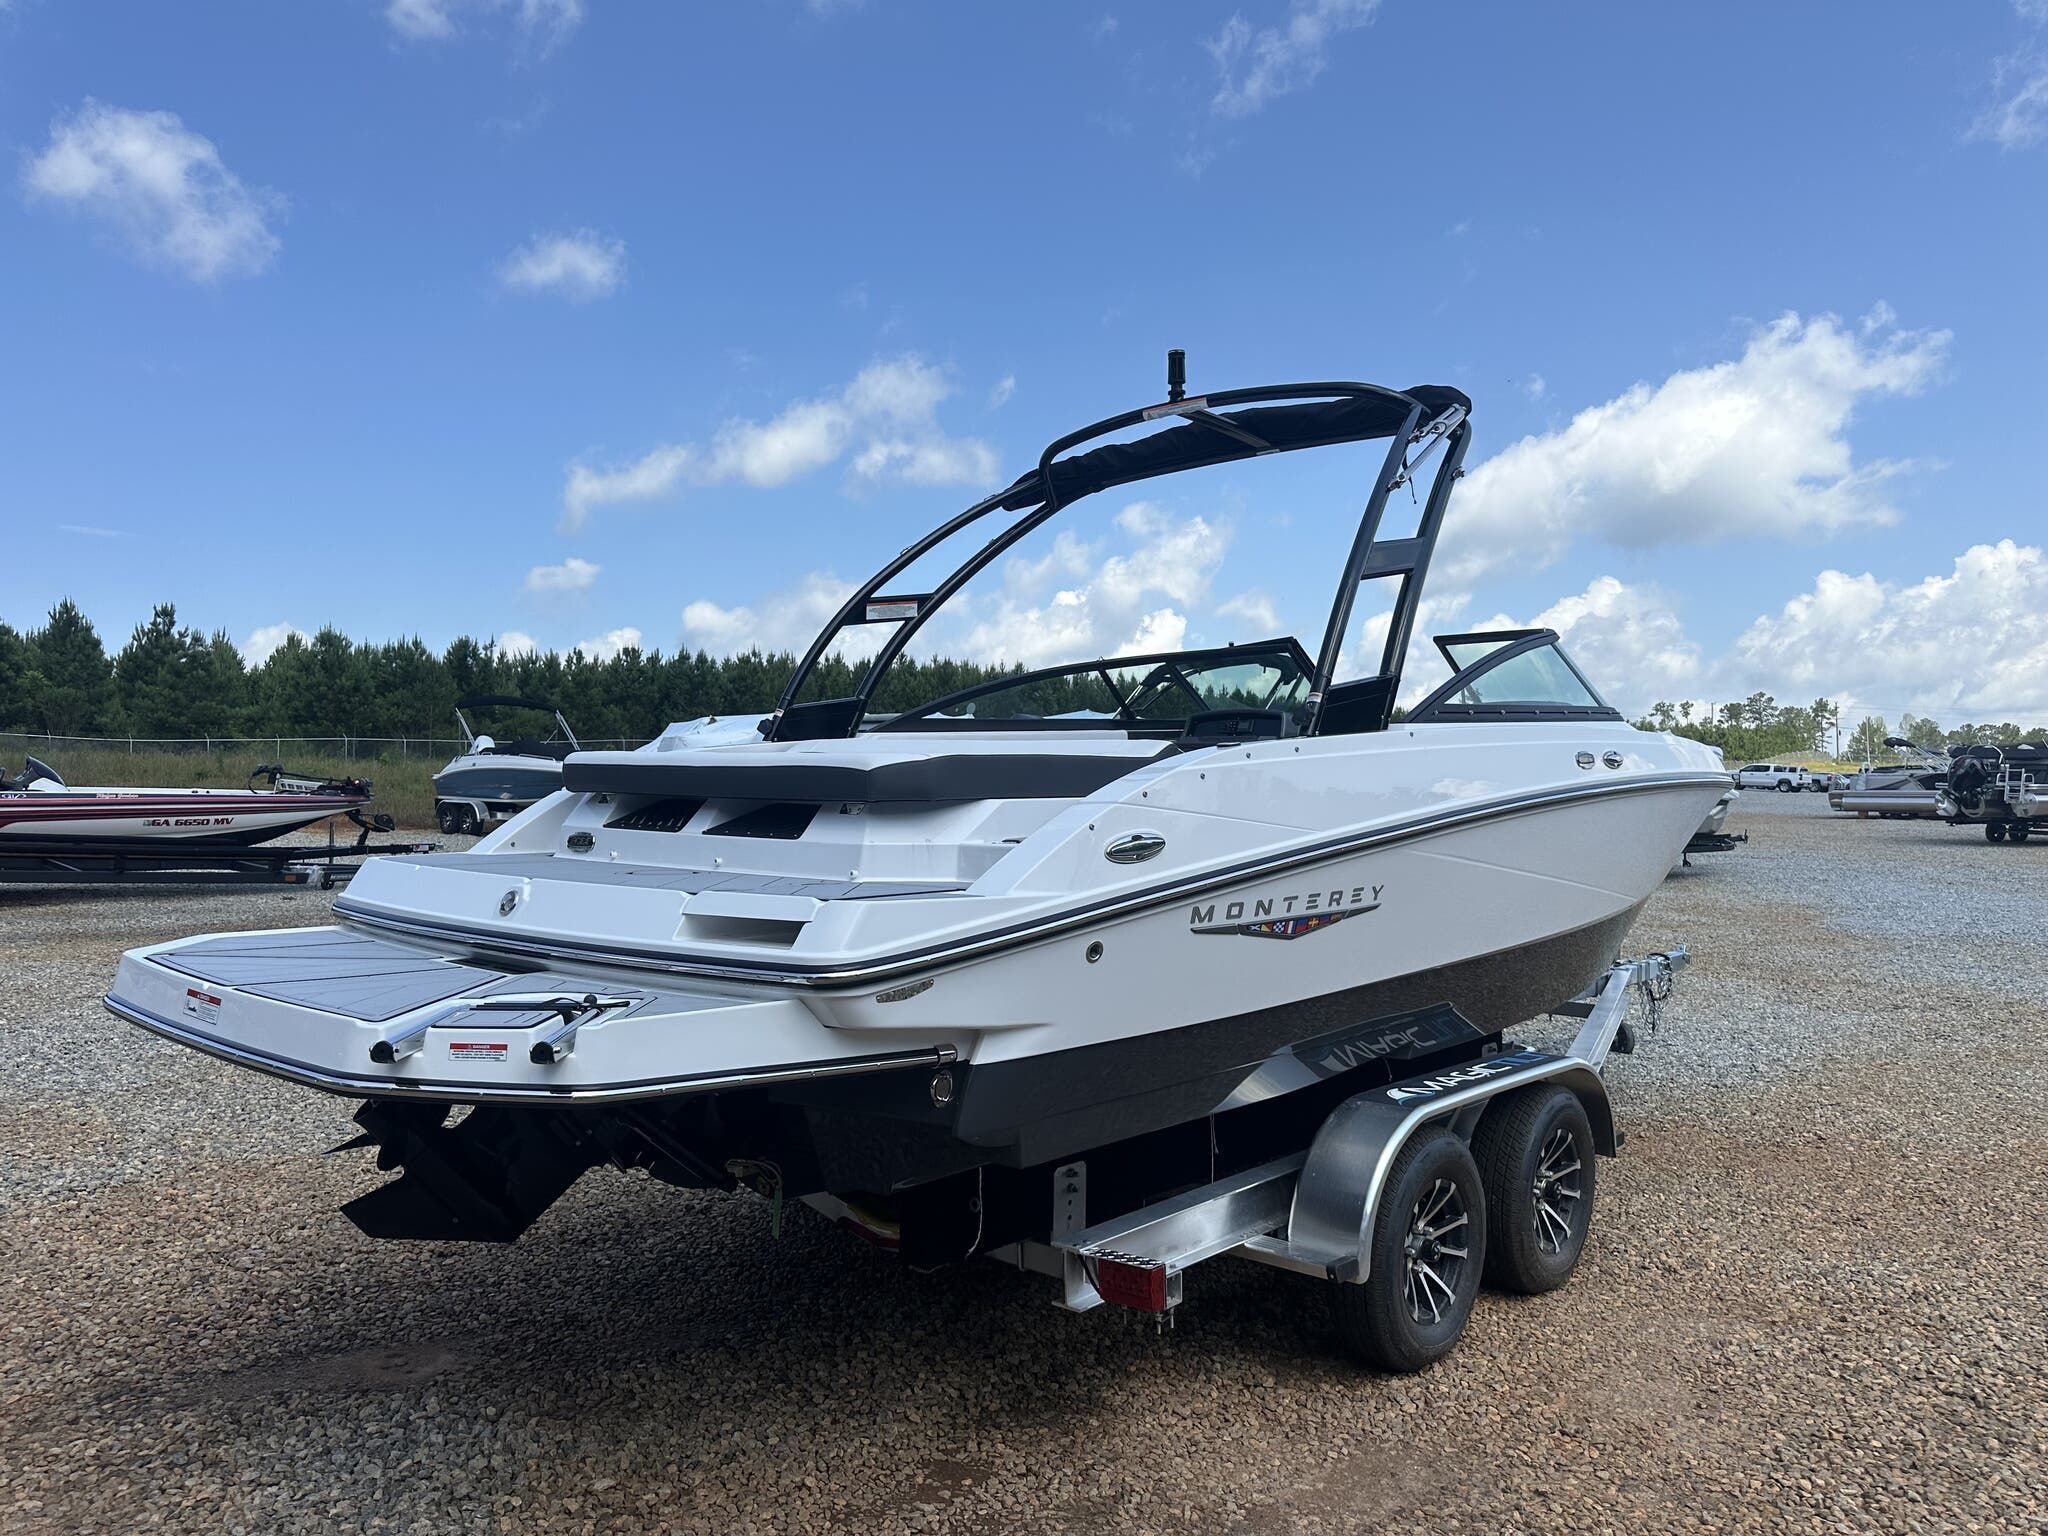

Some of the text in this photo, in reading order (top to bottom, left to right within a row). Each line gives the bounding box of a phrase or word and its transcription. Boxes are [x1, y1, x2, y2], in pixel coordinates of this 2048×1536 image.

[151, 816, 234, 827] GA 6650 MV
[1190, 884, 1385, 924] MONTEREY
